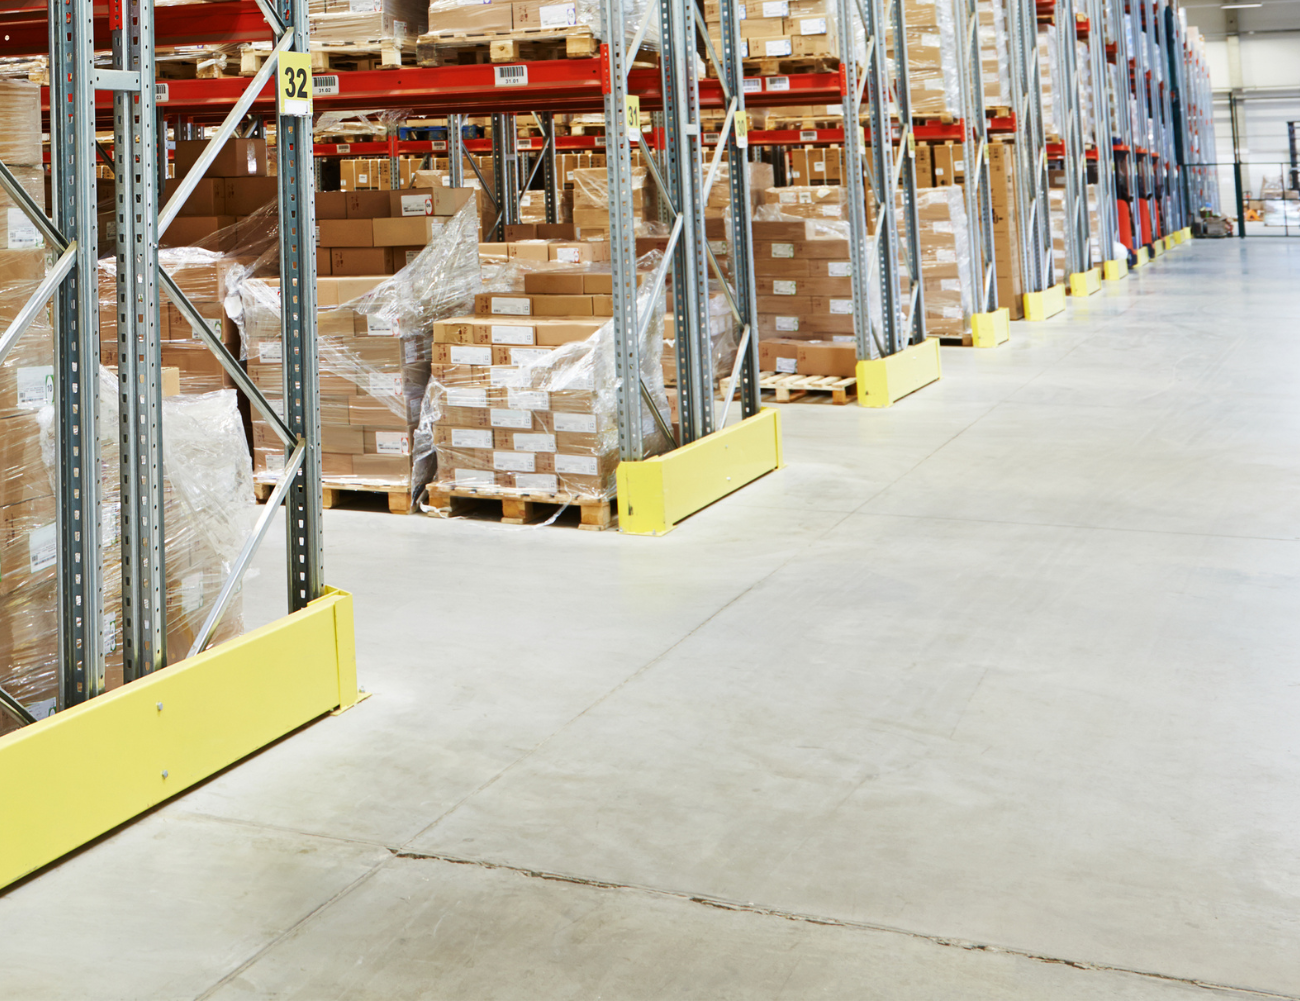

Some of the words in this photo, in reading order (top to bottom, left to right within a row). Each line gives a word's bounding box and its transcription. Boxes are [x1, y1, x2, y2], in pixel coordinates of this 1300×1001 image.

[284, 66, 308, 99] 32
[628, 105, 638, 126] 31
[47, 384, 53, 392] 10
